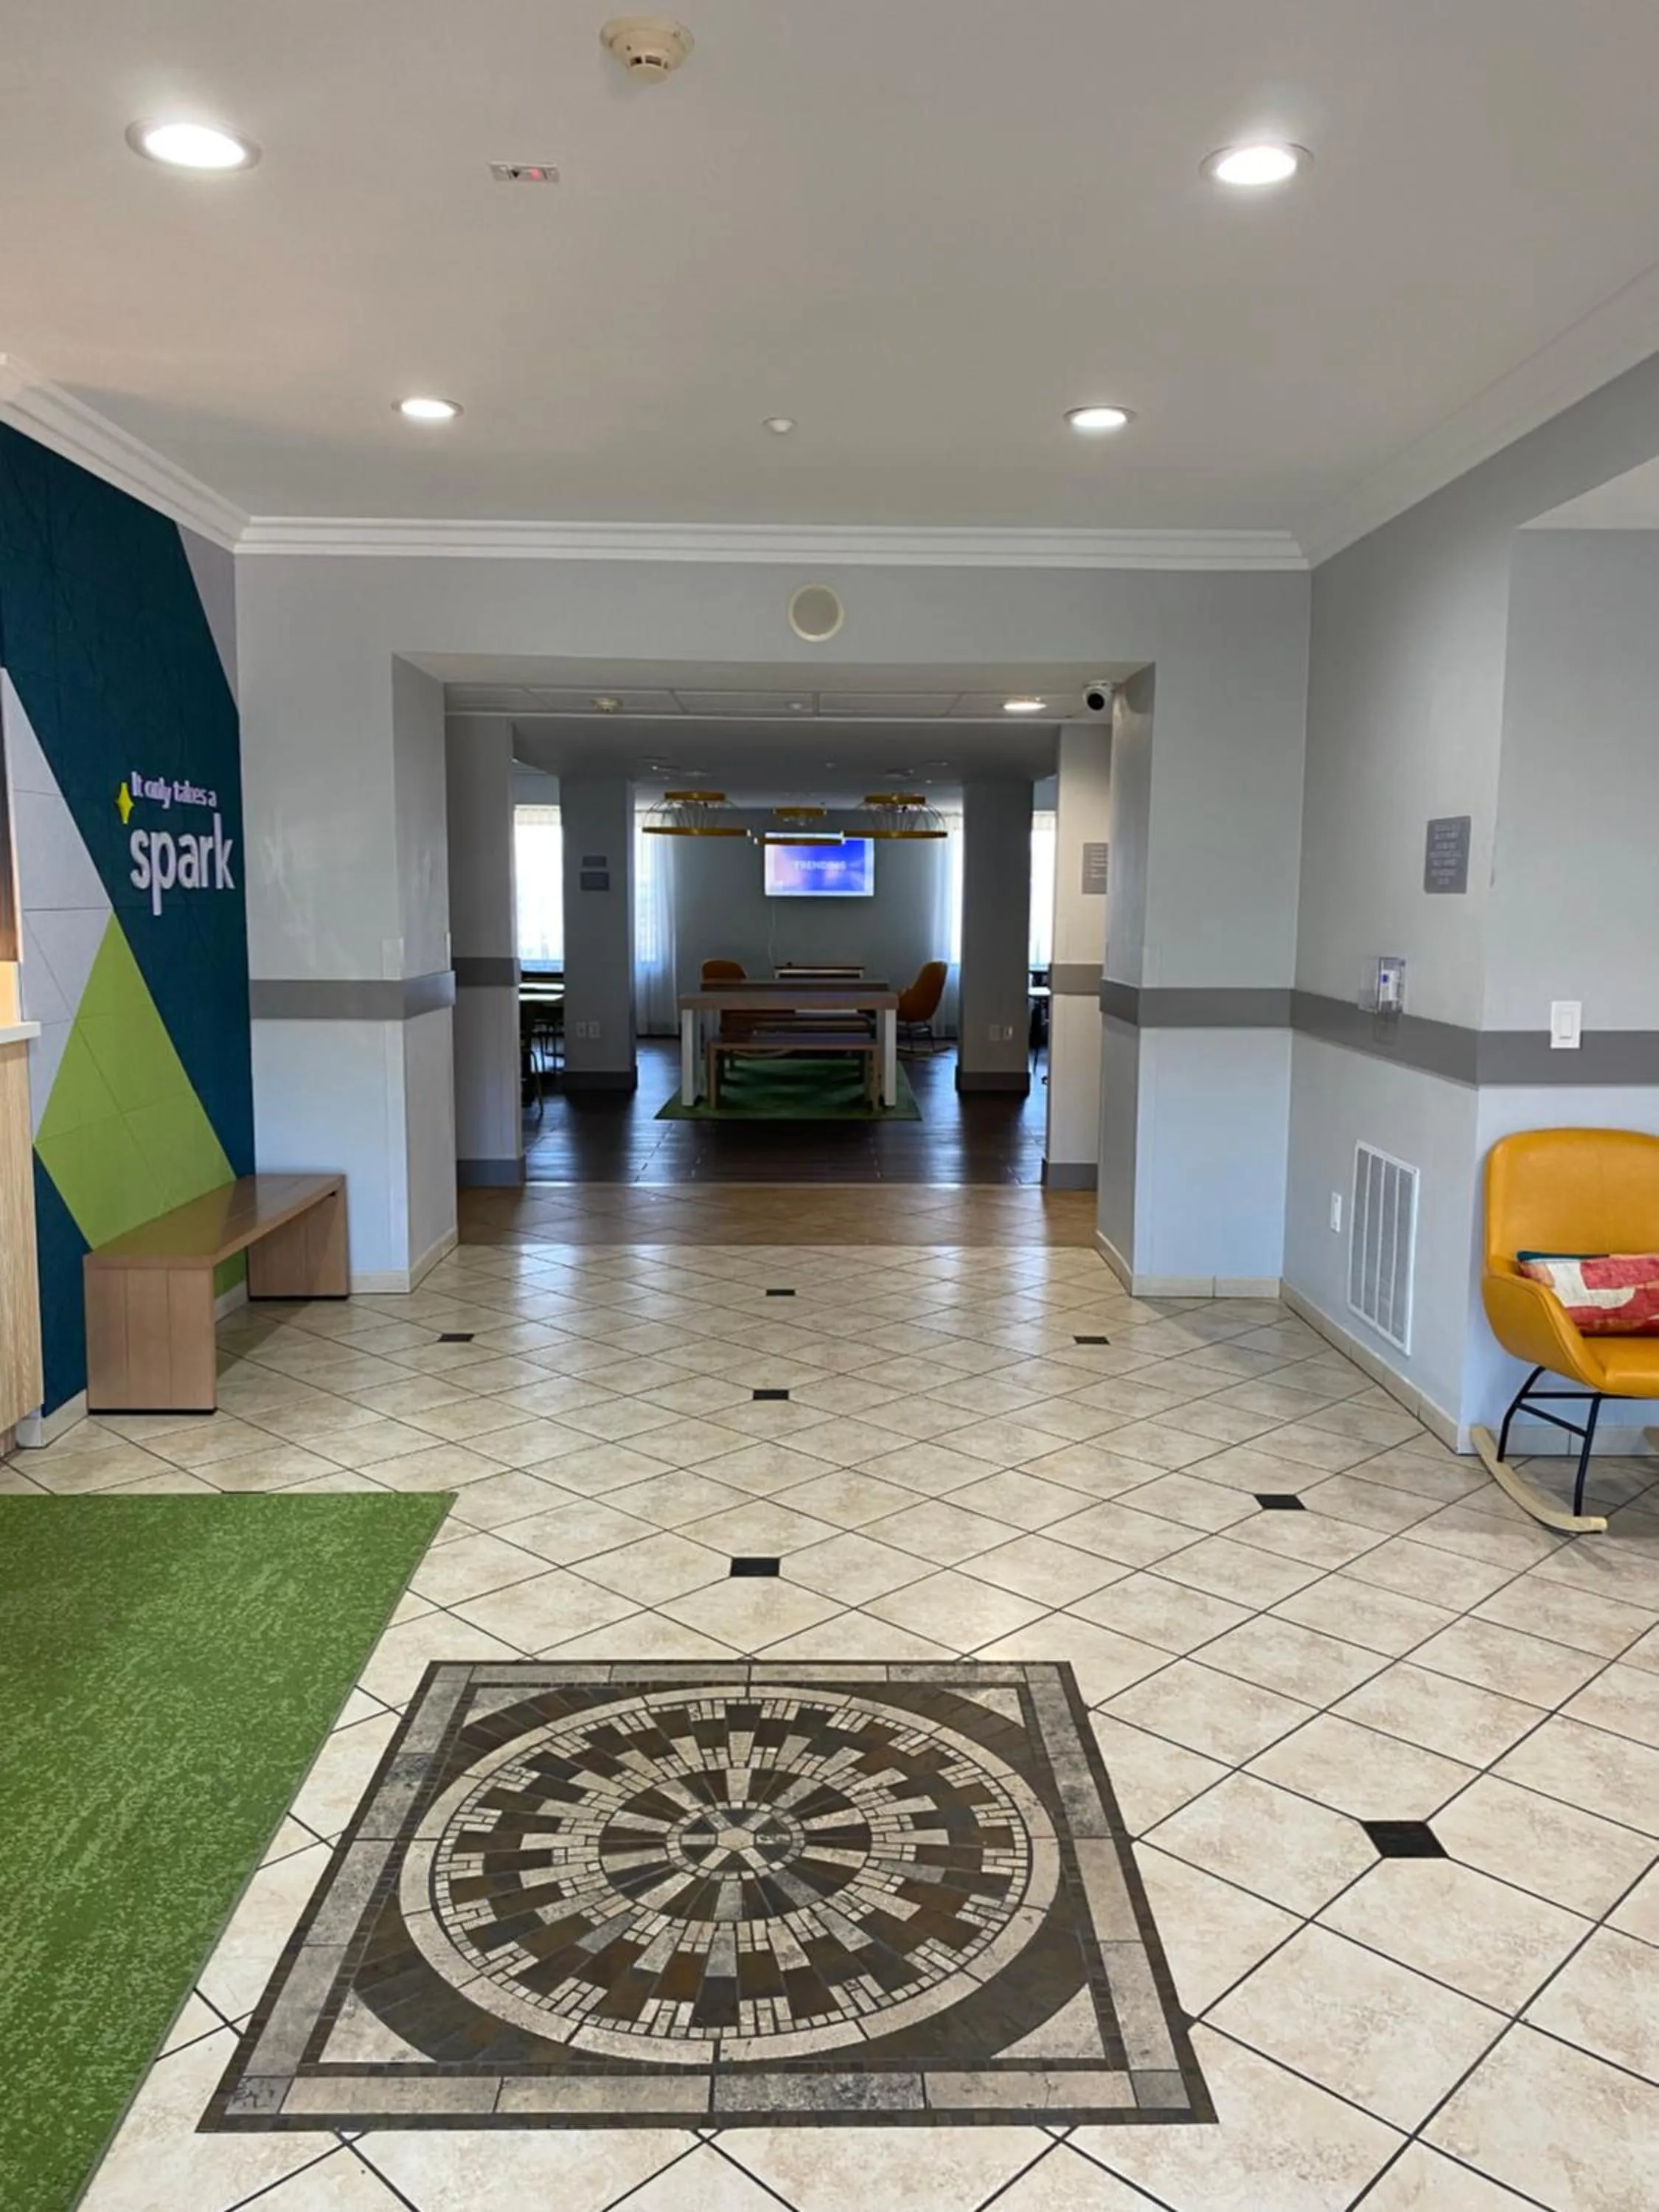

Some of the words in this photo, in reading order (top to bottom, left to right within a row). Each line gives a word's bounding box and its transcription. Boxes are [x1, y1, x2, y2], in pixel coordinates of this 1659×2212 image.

[131, 771, 142, 797] It
[145, 777, 172, 809] only
[173, 780, 207, 806] takes
[208, 790, 217, 807] a
[130, 813, 235, 916] spark
